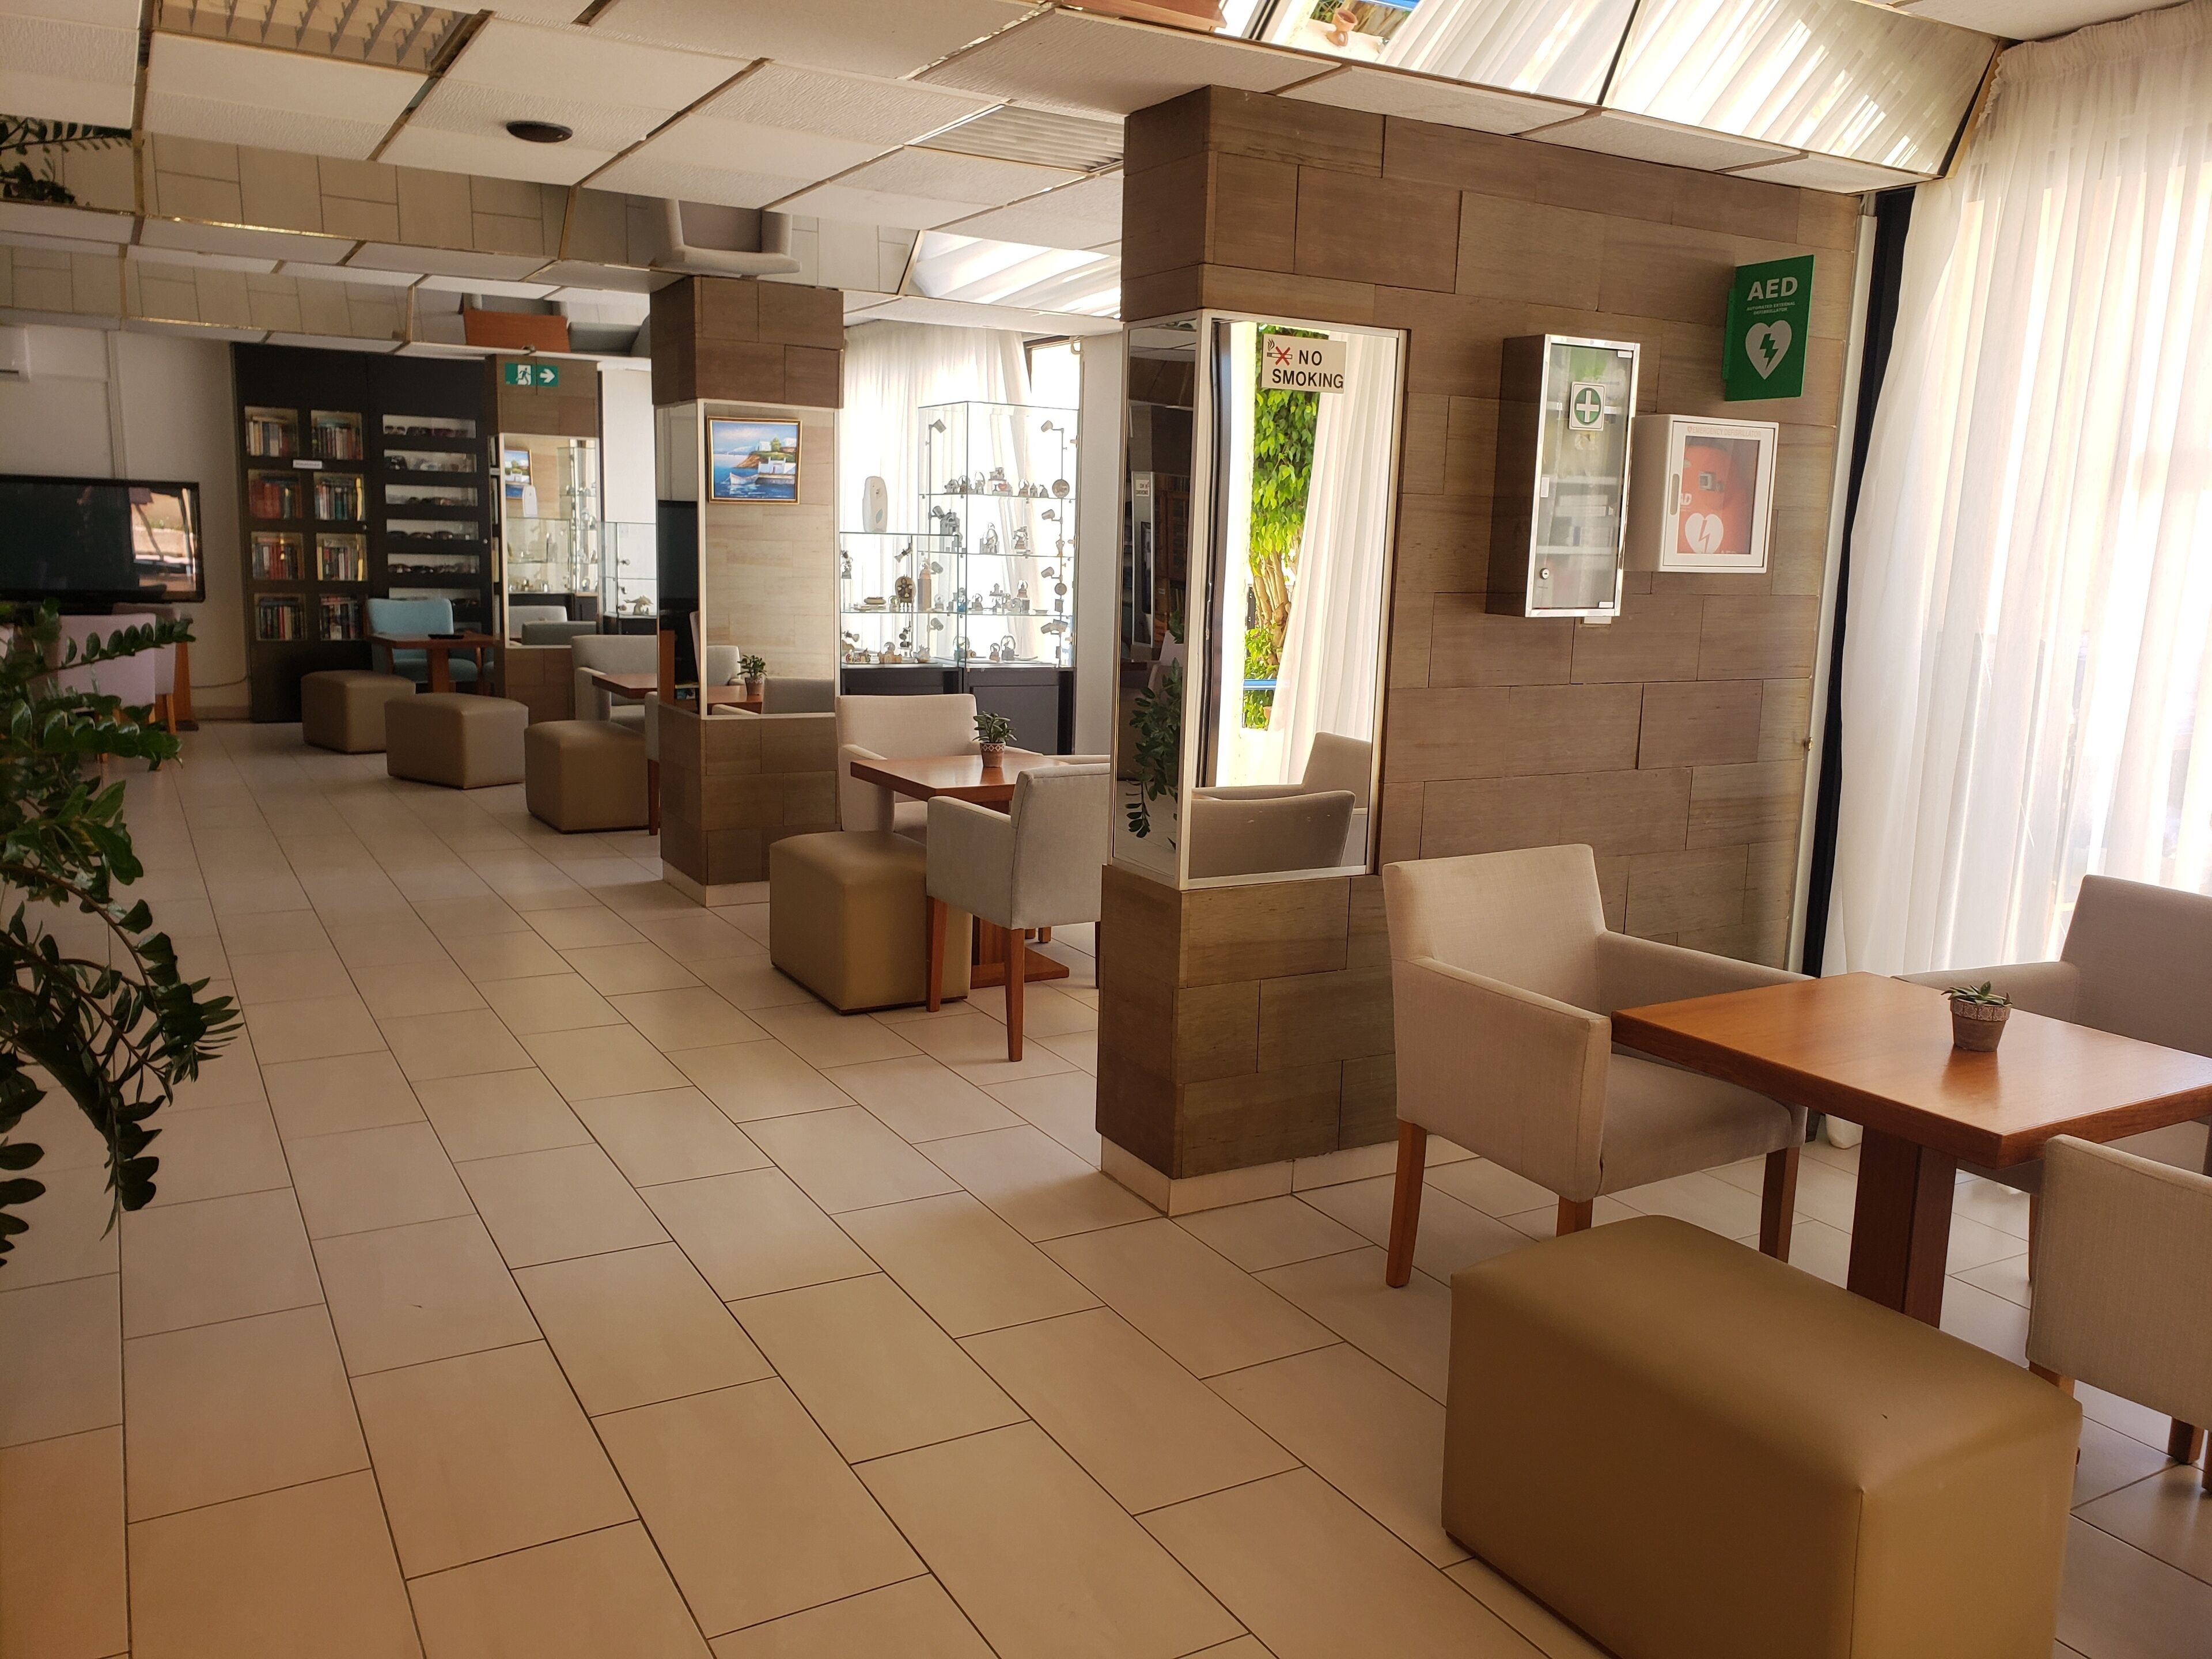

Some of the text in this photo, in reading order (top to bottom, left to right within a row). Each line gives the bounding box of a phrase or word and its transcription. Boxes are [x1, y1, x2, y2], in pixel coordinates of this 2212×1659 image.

[1747, 276, 1798, 301] AED
[1299, 350, 1322, 366] NO
[1272, 368, 1344, 389] SMOKING
[1692, 426, 1761, 437] EMERGENCY DEFIBRILLATOR
